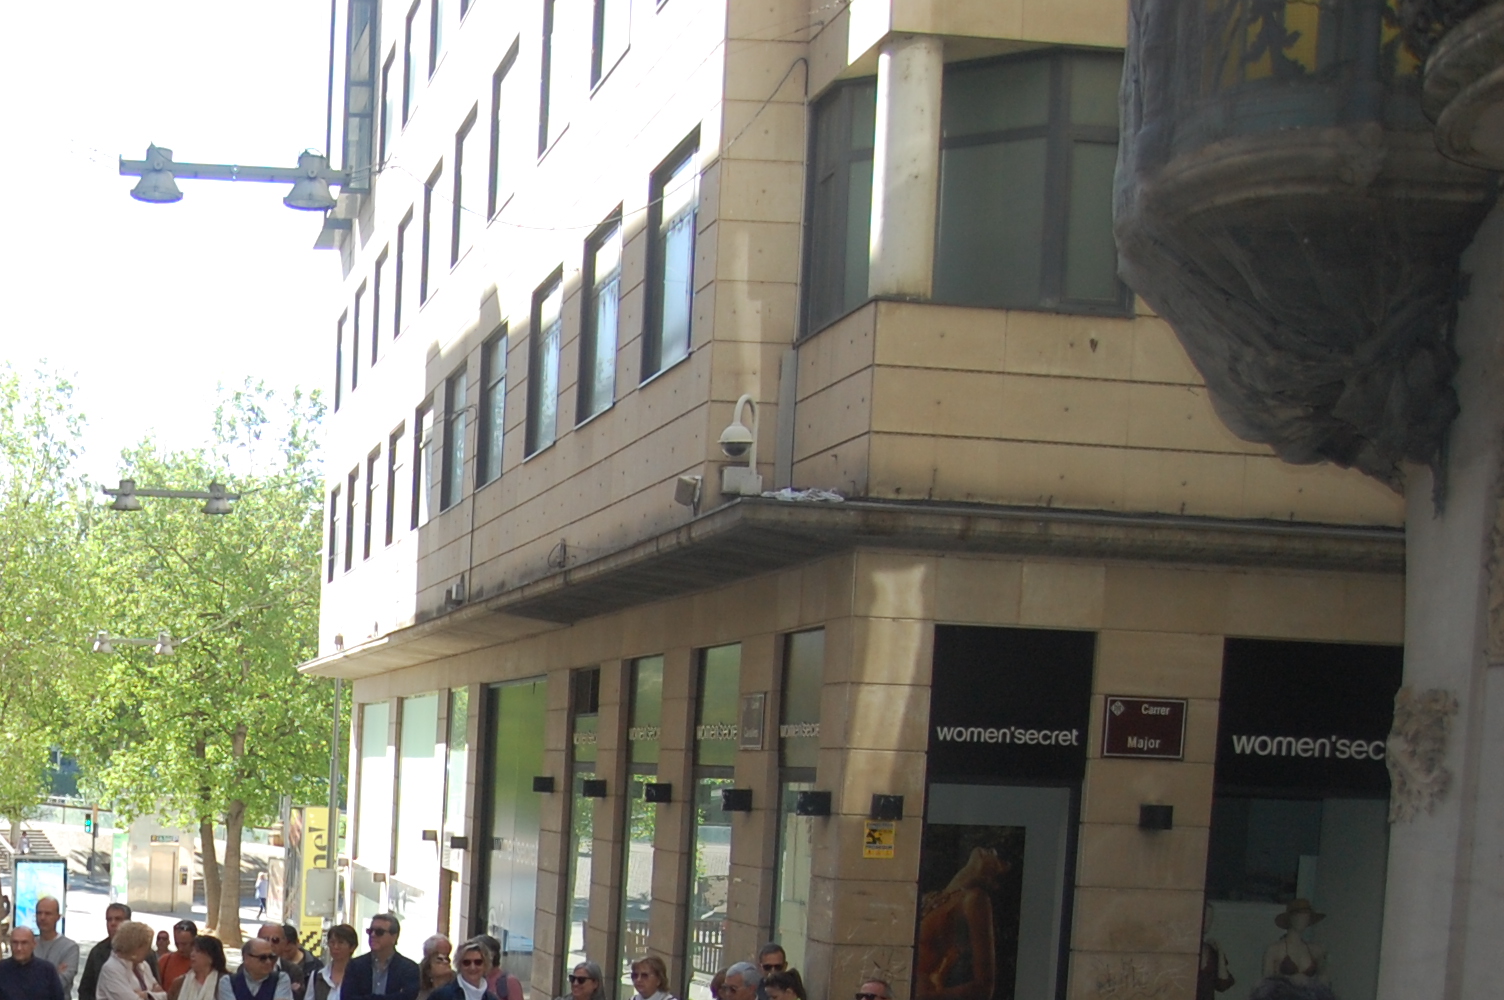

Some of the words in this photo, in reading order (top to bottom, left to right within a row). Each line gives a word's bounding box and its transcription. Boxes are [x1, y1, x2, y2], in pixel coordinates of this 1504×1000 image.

[1141, 703, 1171, 716] Carrer
[936, 725, 1080, 747] women'secret
[1127, 736, 1162, 752] Major
